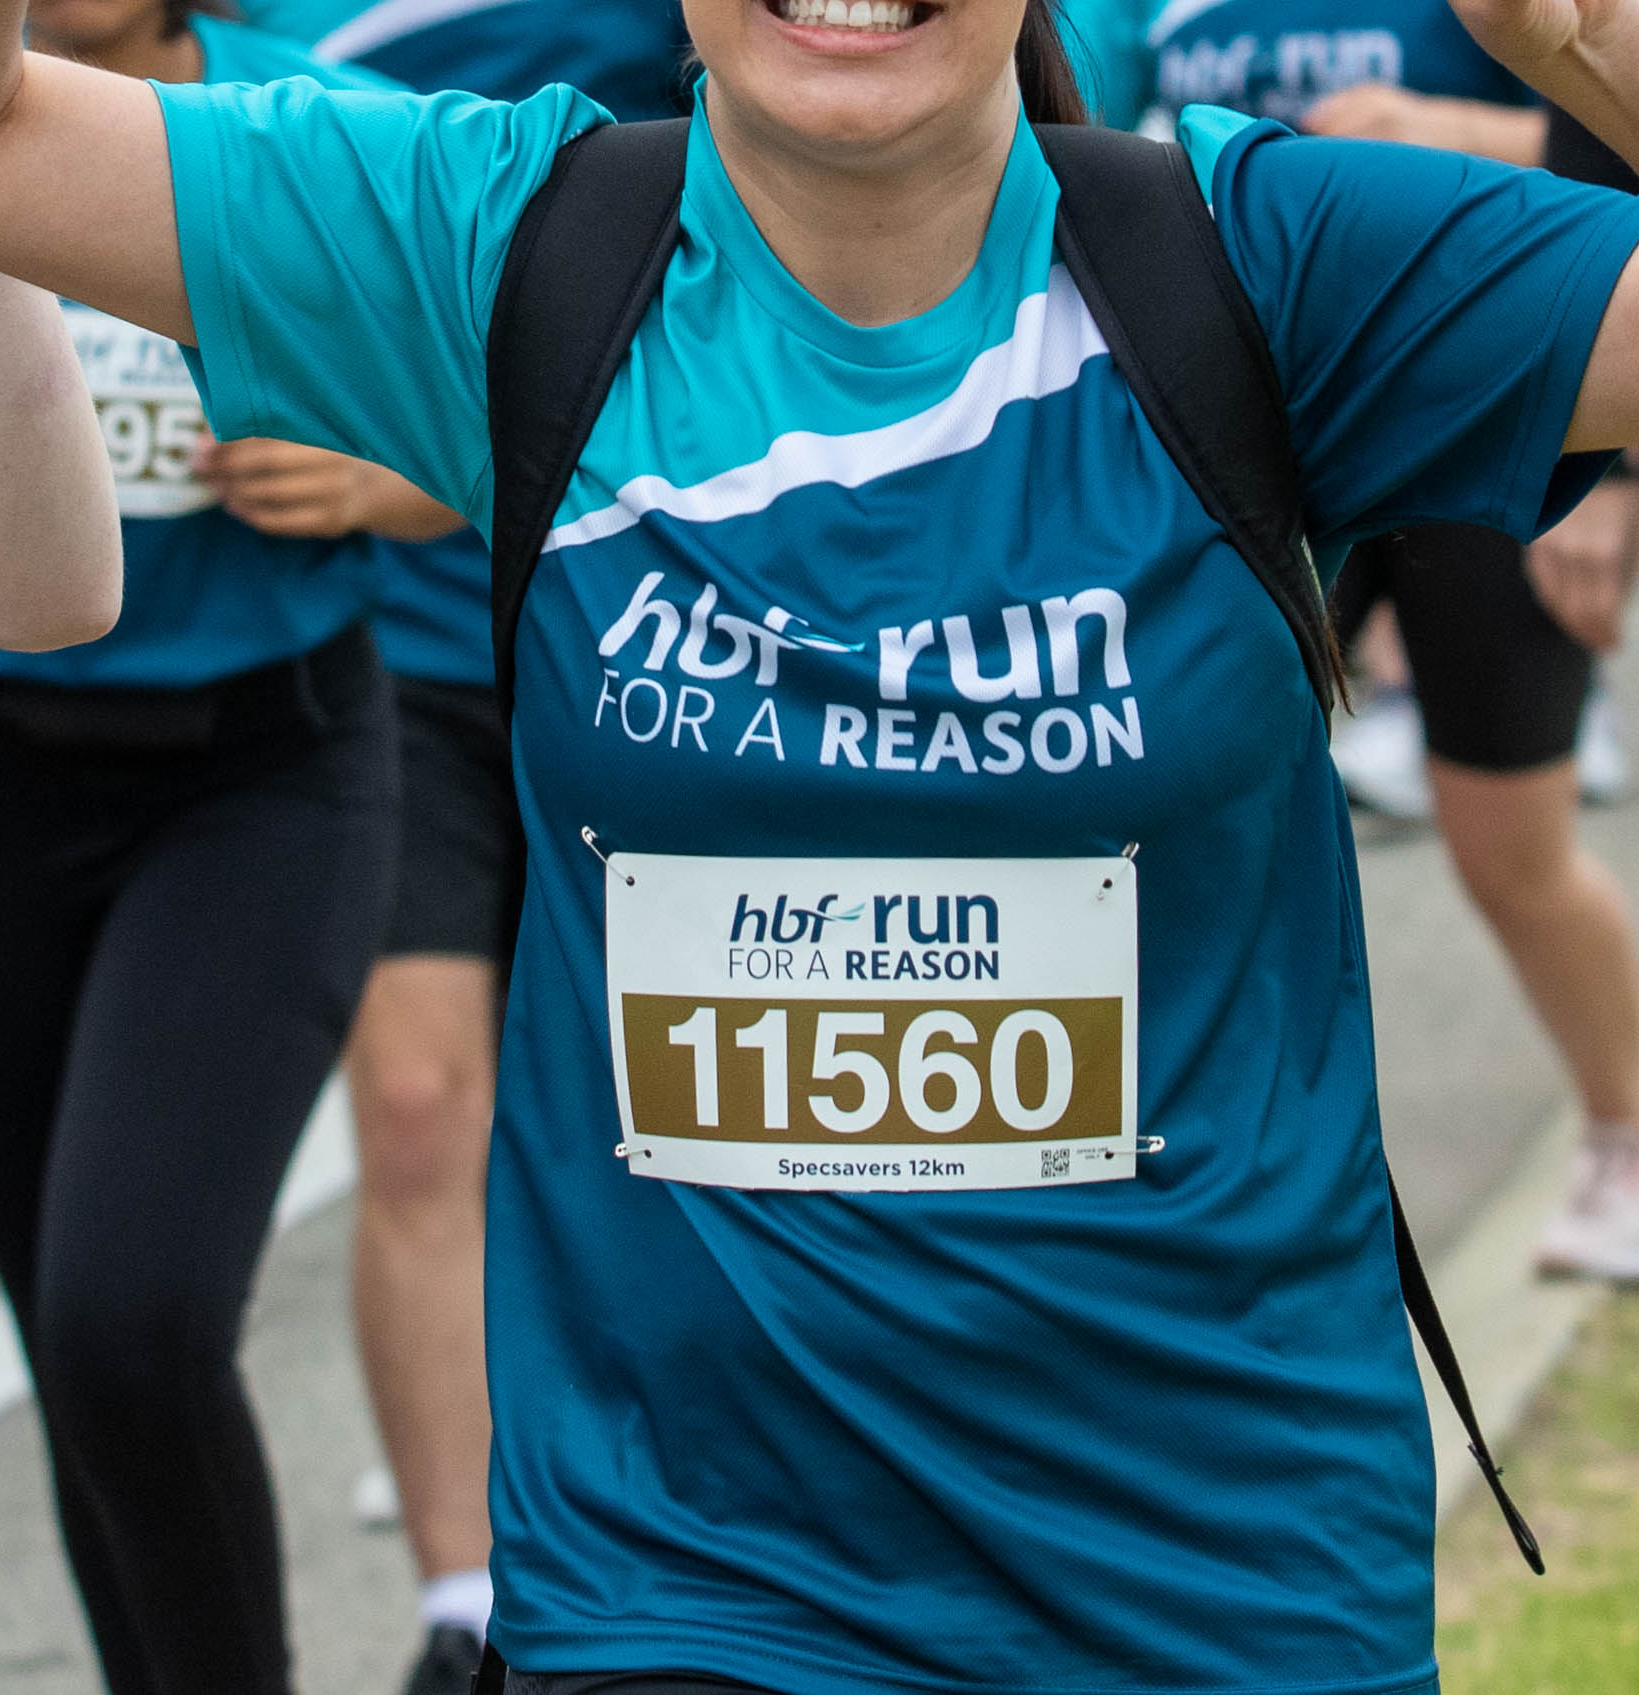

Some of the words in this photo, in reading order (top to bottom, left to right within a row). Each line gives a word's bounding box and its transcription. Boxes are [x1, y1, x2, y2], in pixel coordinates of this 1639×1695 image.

[598, 570, 812, 687] hbf
[878, 587, 1133, 702] run
[594, 668, 716, 754] FOR
[735, 697, 786, 762] A
[819, 696, 1146, 776] REASON
[729, 893, 840, 945] hbf
[873, 893, 1000, 945] run
[728, 948, 794, 981] FOR
[805, 949, 830, 981] A
[844, 949, 1000, 981] REASON
[668, 1006, 1075, 1134] 11560
[778, 1158, 902, 1179] Specsavers
[909, 1158, 966, 1177] 12km
